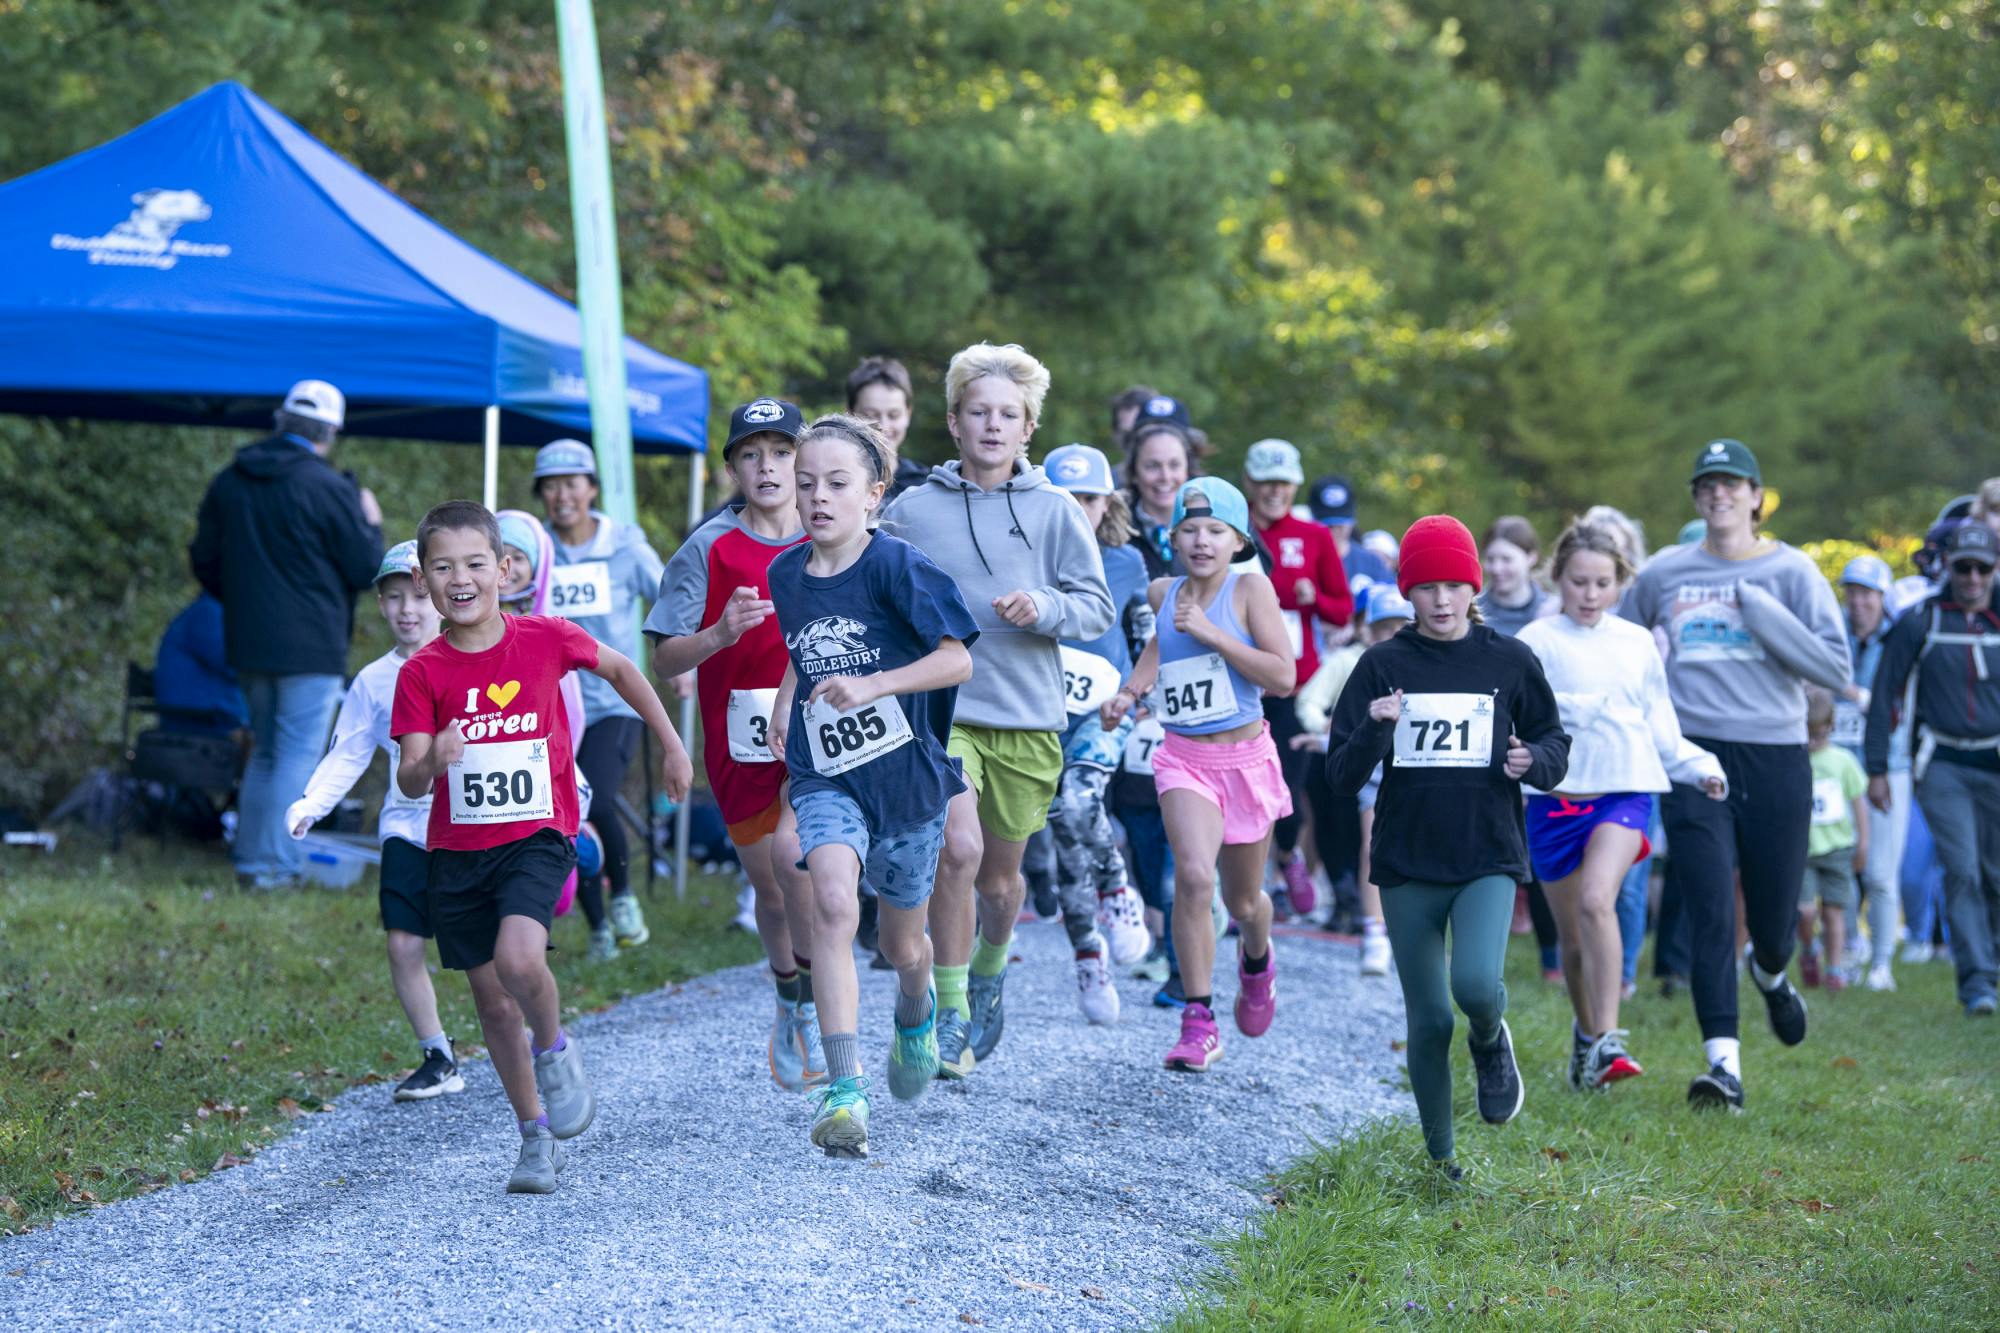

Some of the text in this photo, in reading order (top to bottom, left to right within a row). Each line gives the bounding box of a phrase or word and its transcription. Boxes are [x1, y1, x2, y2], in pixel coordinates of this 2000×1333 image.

[552, 583, 596, 607] 529
[800, 647, 881, 675] IDDLEBURY
[464, 687, 480, 713] I
[1065, 671, 1093, 701] 63
[1164, 679, 1213, 716] 547
[457, 712, 538, 743] Korea
[819, 705, 886, 759] 685
[1410, 720, 1469, 751] 721
[463, 769, 533, 808] 530
